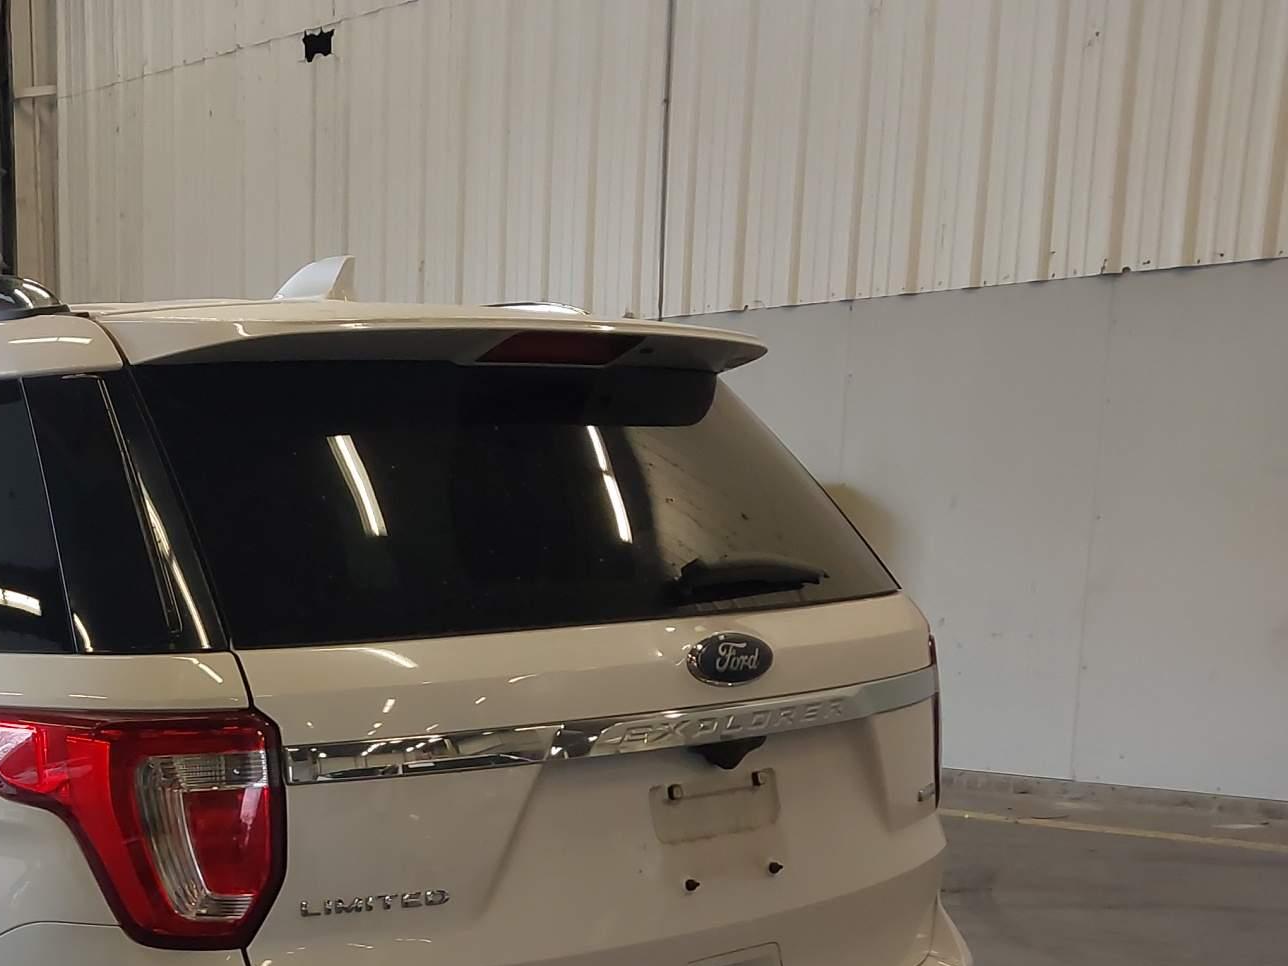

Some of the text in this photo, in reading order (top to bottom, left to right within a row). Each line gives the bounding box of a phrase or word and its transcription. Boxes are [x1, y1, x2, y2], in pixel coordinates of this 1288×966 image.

[715, 641, 760, 672] Ford
[619, 697, 846, 745] EXPLORER
[300, 889, 451, 918] LIMITED
